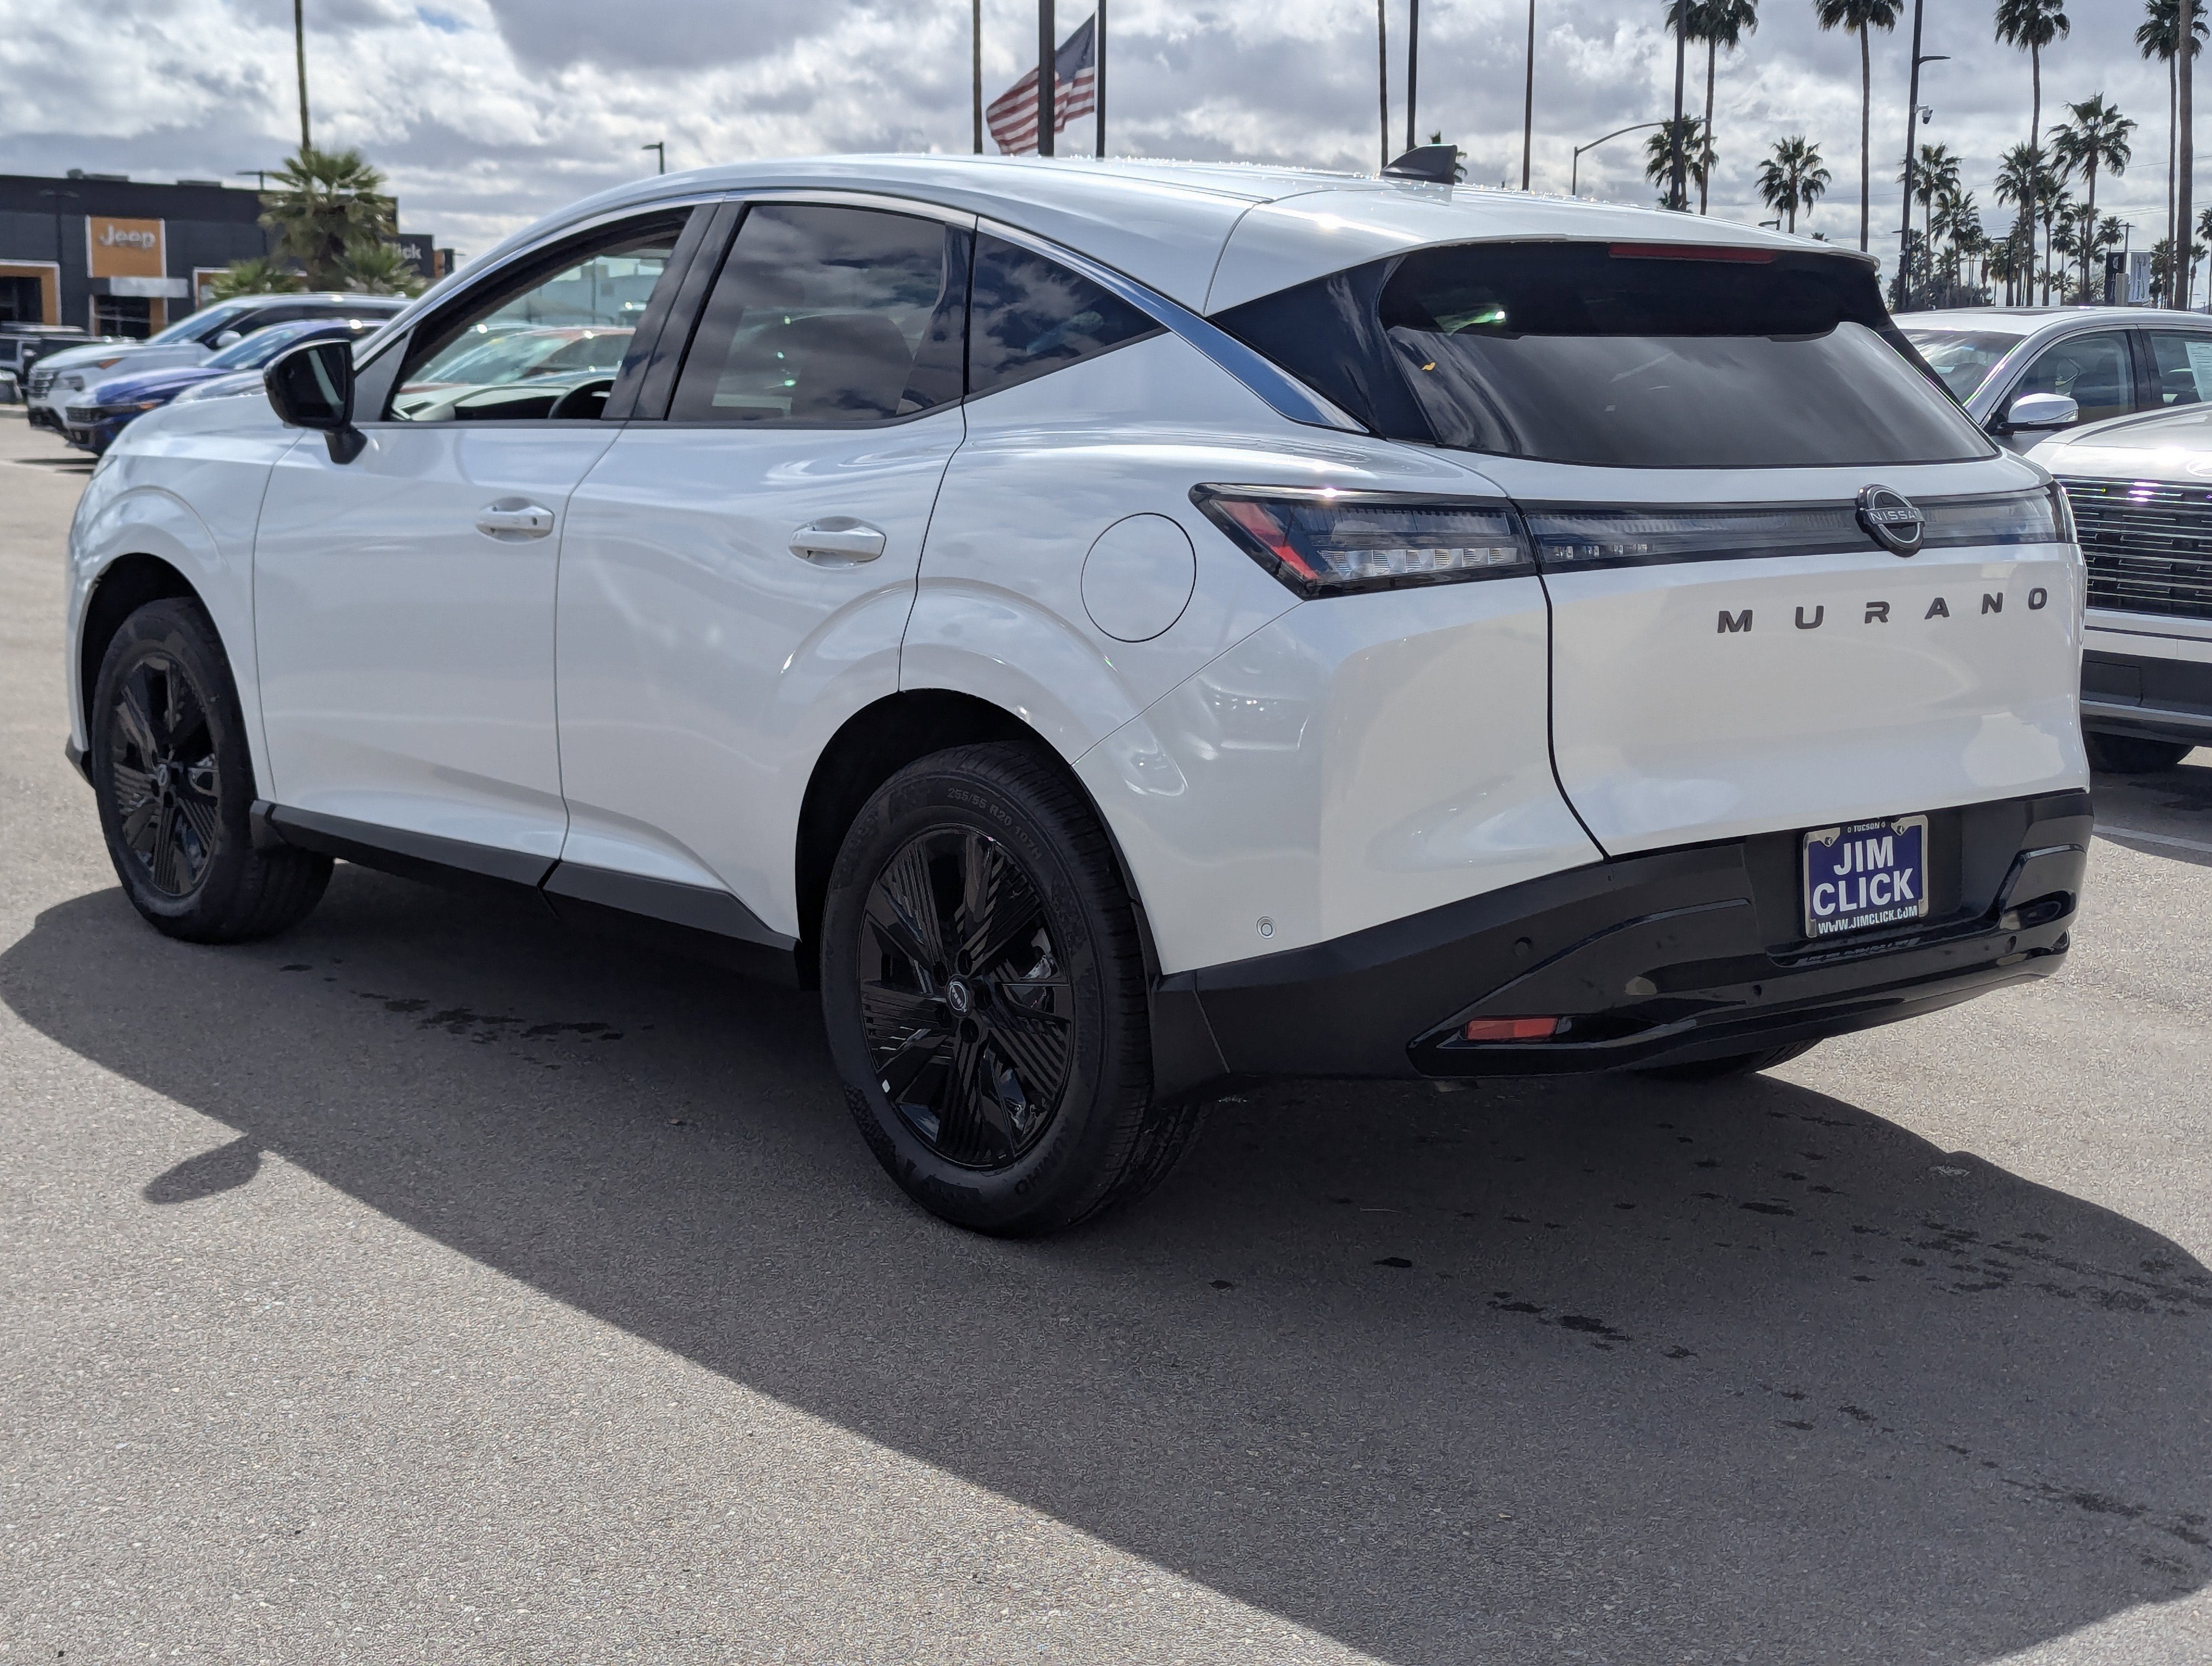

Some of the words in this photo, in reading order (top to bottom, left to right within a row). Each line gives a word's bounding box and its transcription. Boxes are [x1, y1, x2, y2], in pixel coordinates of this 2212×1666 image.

[99, 225, 156, 249] Jeep
[1717, 587, 2047, 633] MURANO
[947, 786, 987, 809] 255/55
[989, 804, 1012, 826] R20
[1853, 822, 1880, 832] TUCSON
[1833, 836, 1893, 875] JIM
[1813, 868, 1914, 915] CLICK
